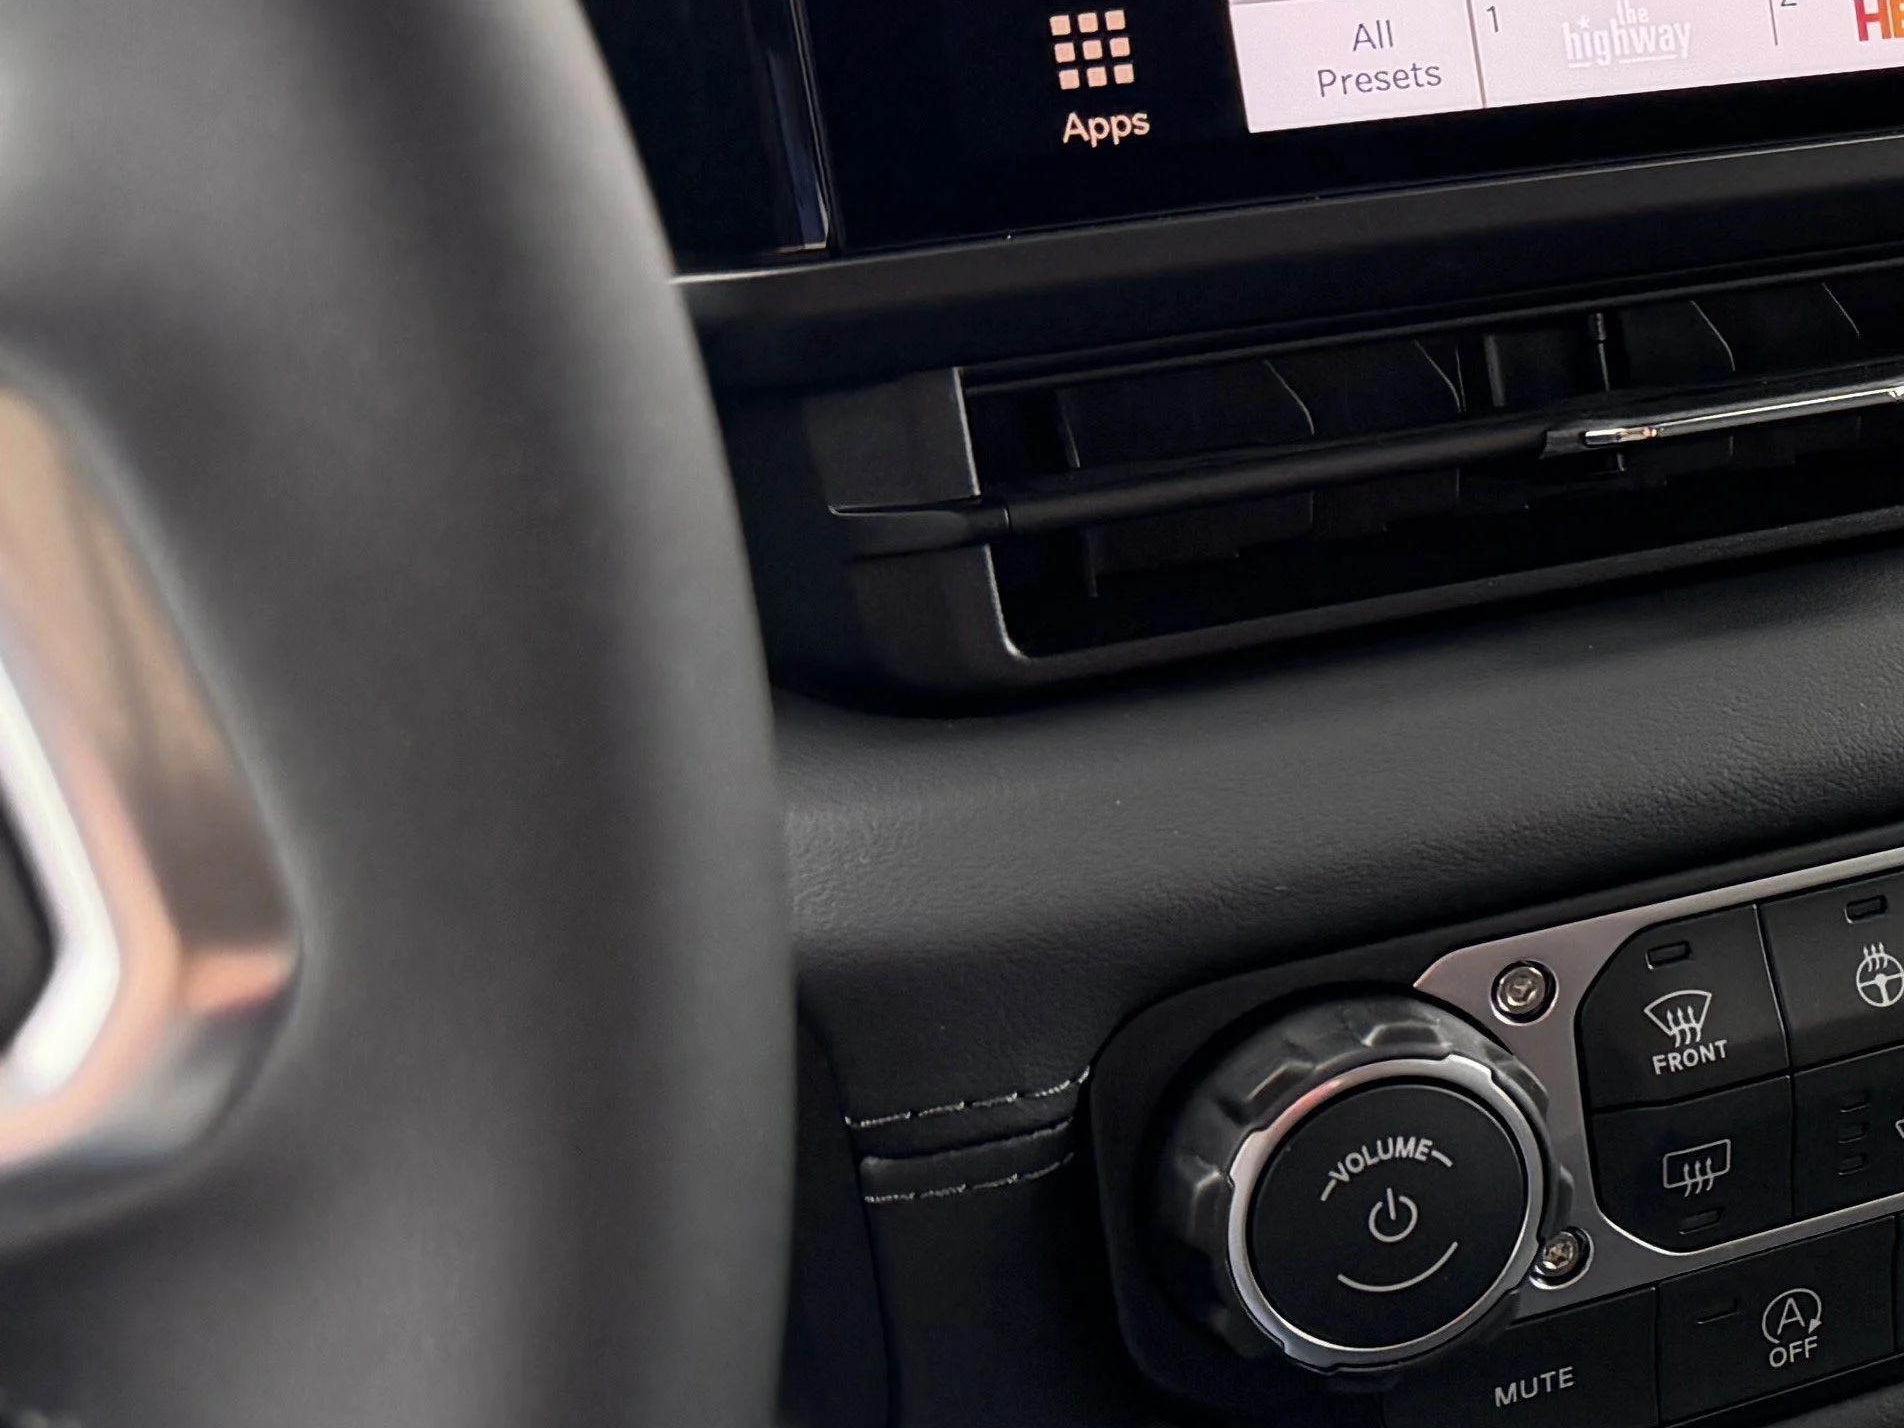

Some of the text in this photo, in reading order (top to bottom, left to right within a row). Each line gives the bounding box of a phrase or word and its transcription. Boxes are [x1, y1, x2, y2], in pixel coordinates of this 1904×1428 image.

[1351, 19, 1395, 52] All
[1486, 5, 1500, 33] 1
[1562, 17, 1692, 66] highway
[1317, 60, 1442, 97] Presets
[1062, 111, 1151, 148] Apps
[1652, 1039, 1729, 1075] FRONT
[1328, 1135, 1434, 1186] VOLUME
[1767, 1336, 1819, 1369] OFF
[1494, 1366, 1575, 1408] MUTE
